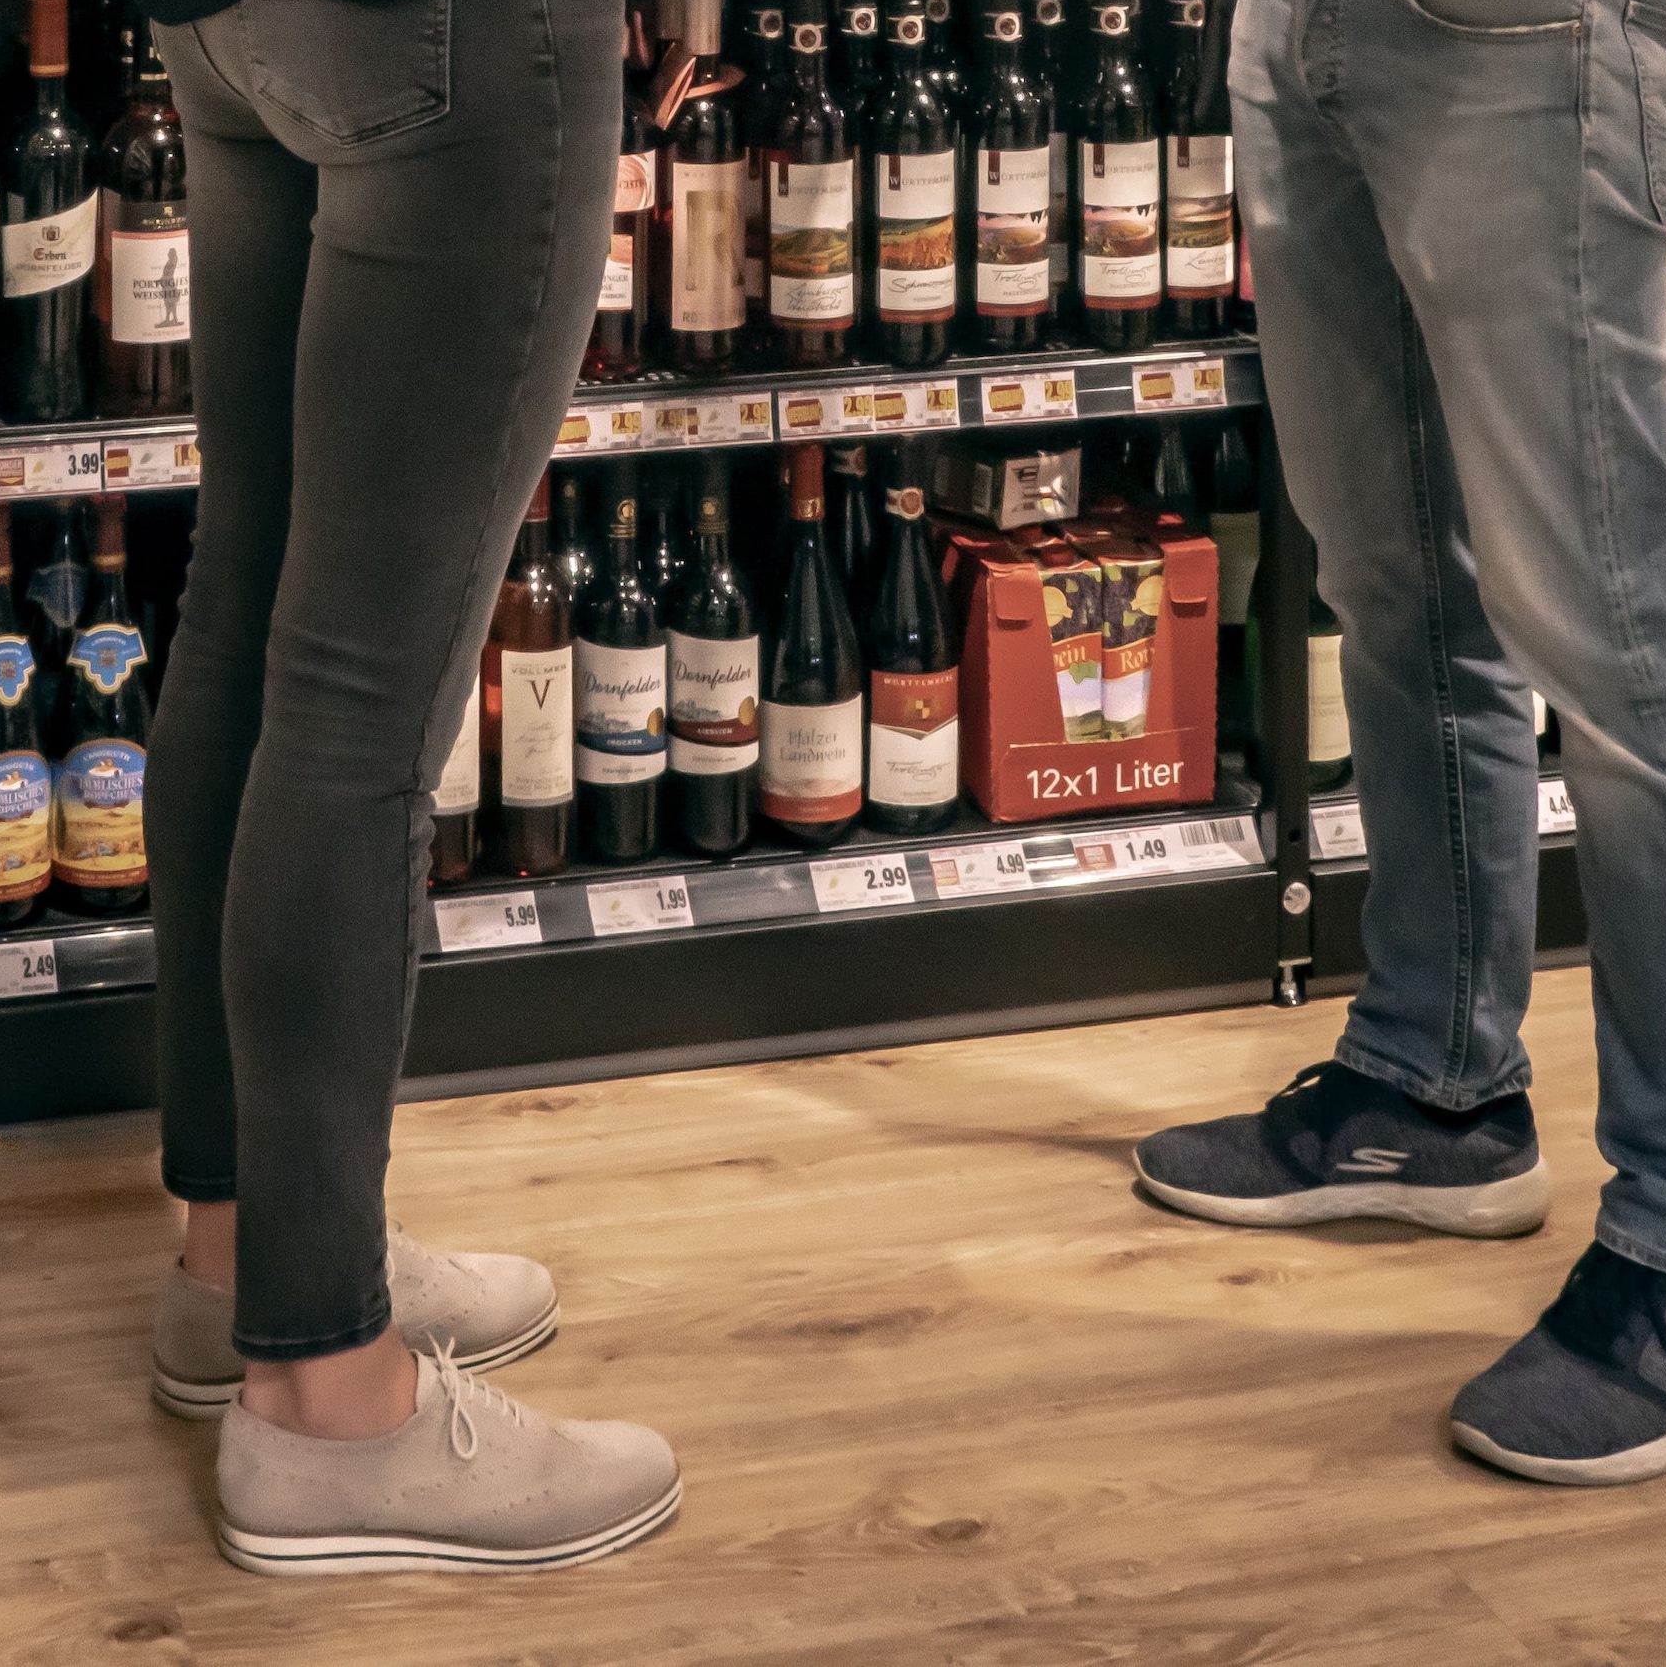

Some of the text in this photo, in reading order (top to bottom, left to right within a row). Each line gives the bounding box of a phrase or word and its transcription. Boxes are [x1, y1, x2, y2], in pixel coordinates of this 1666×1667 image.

[33, 248, 67, 261] Erben
[68, 453, 99, 475] 3.99
[511, 664, 567, 675] VOLLMER
[675, 662, 752, 689] Dornfelder
[530, 680, 552, 709] V
[585, 672, 663, 700] Dornfelder
[1027, 758, 1184, 799] 12x1 Liter
[1125, 838, 1166, 862] 1.49
[996, 853, 1024, 875] 4.99
[864, 867, 907, 889] 2.99
[657, 889, 686, 910] 1.99
[505, 905, 536, 927] 5.99
[23, 955, 55, 978] 2.49
